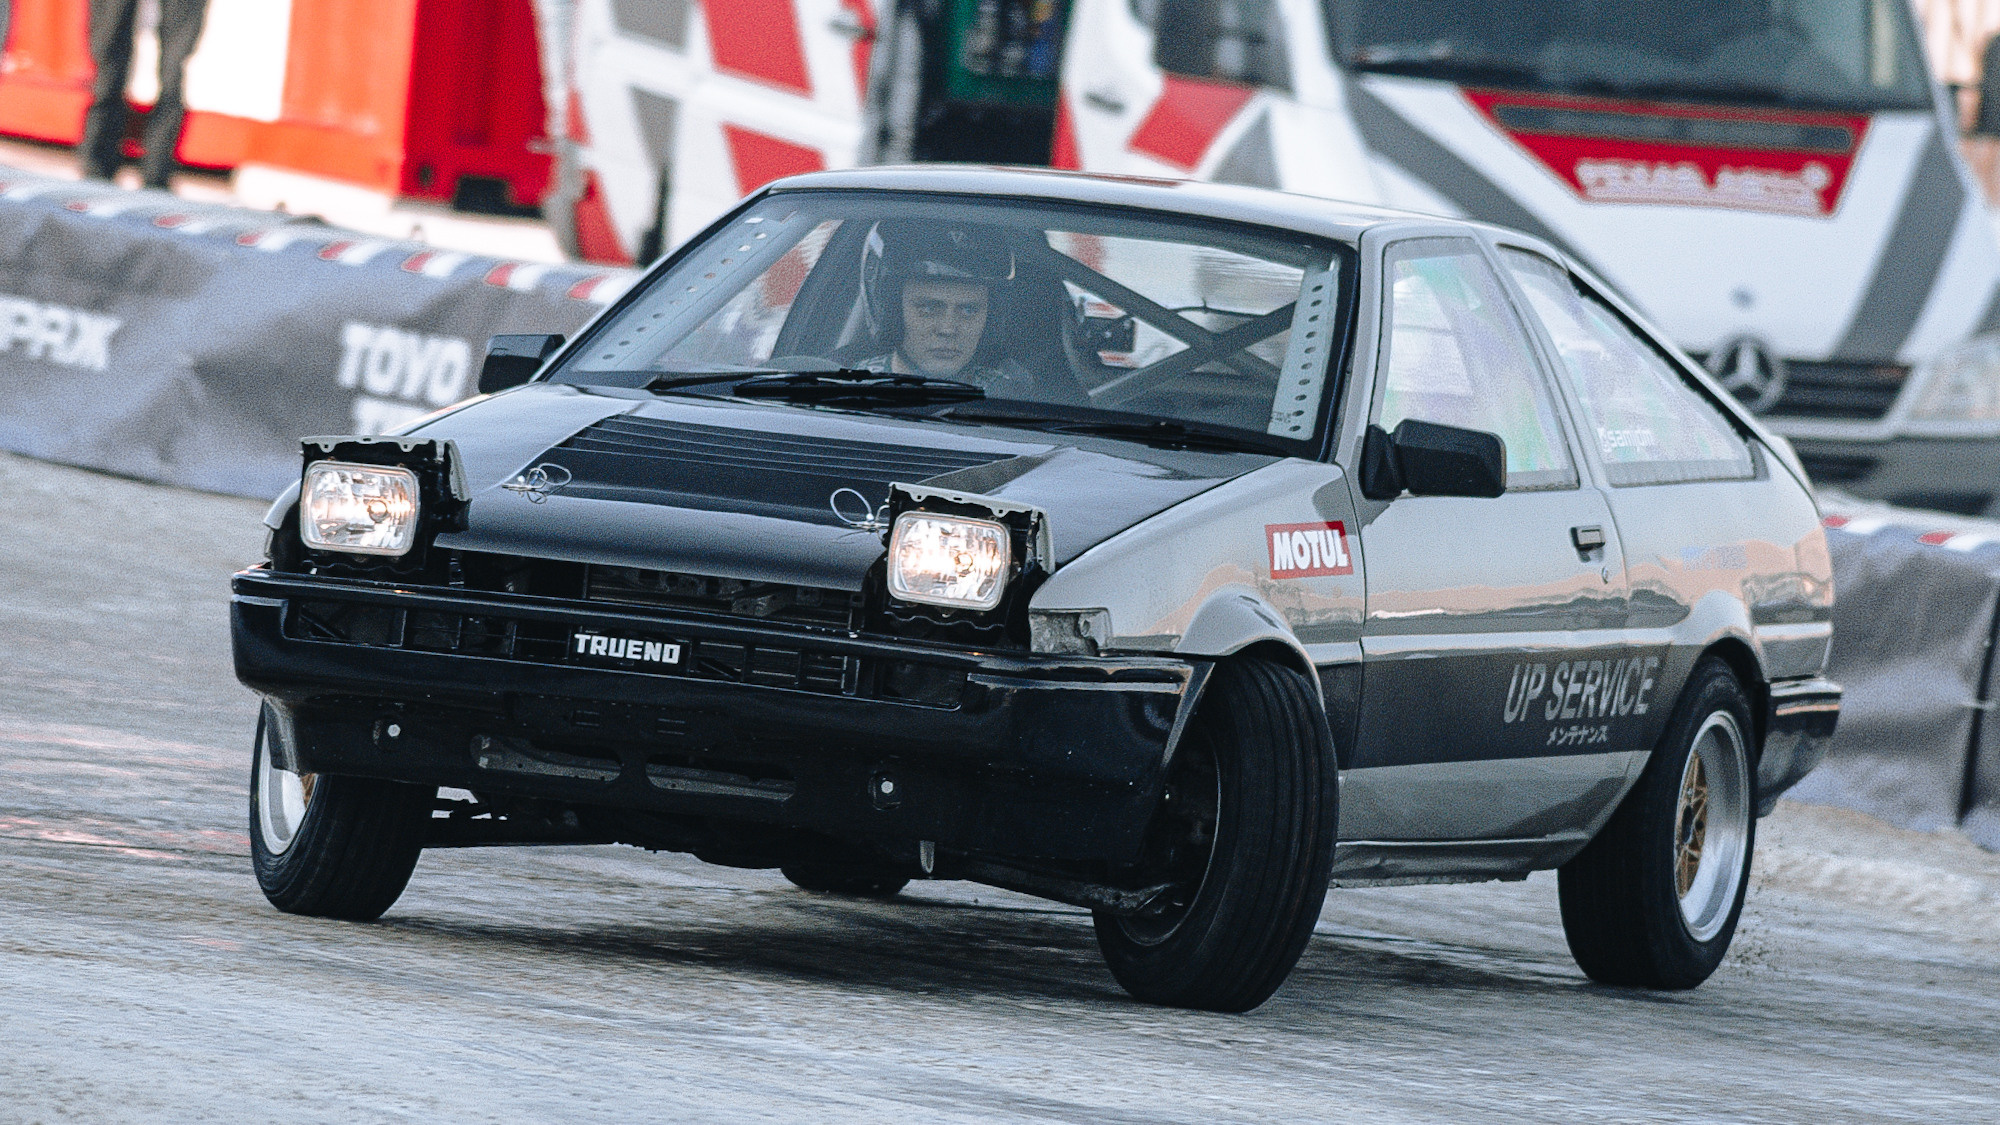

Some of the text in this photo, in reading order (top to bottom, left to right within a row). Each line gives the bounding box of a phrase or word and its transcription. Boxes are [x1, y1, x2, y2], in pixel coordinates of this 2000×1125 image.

[339, 323, 470, 404] TOYO
[1272, 529, 1348, 571] MOTUL
[574, 633, 681, 665] TRUENO
[1503, 656, 1659, 723] UP SERVICE
[1546, 725, 1609, 746] メンテナンス
